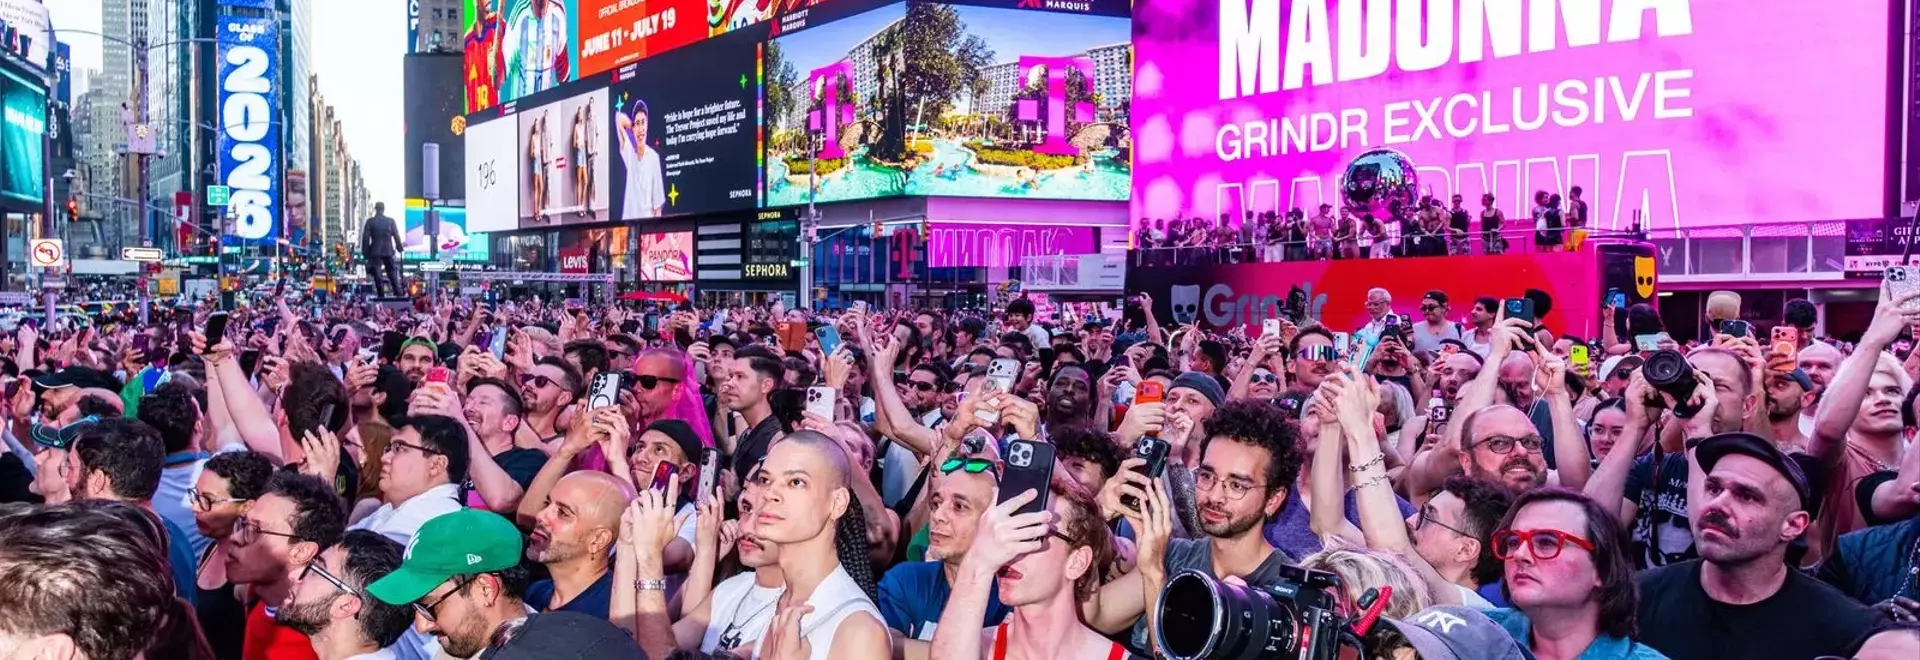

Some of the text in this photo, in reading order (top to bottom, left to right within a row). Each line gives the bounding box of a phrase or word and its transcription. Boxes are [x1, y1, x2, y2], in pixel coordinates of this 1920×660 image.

[1046, 0, 1091, 11] MARQUIS
[581, 31, 610, 59] JUNE
[611, 27, 623, 48] 11
[630, 13, 660, 42] JULY
[661, 7, 677, 30] 19
[1215, 69, 1693, 161] GRINDR EXCLUSIVE
[223, 45, 273, 239] 2026
[729, 188, 752, 199] SEPHORA
[757, 211, 781, 220] SEPHORA
[745, 263, 787, 277] SEPHORA
